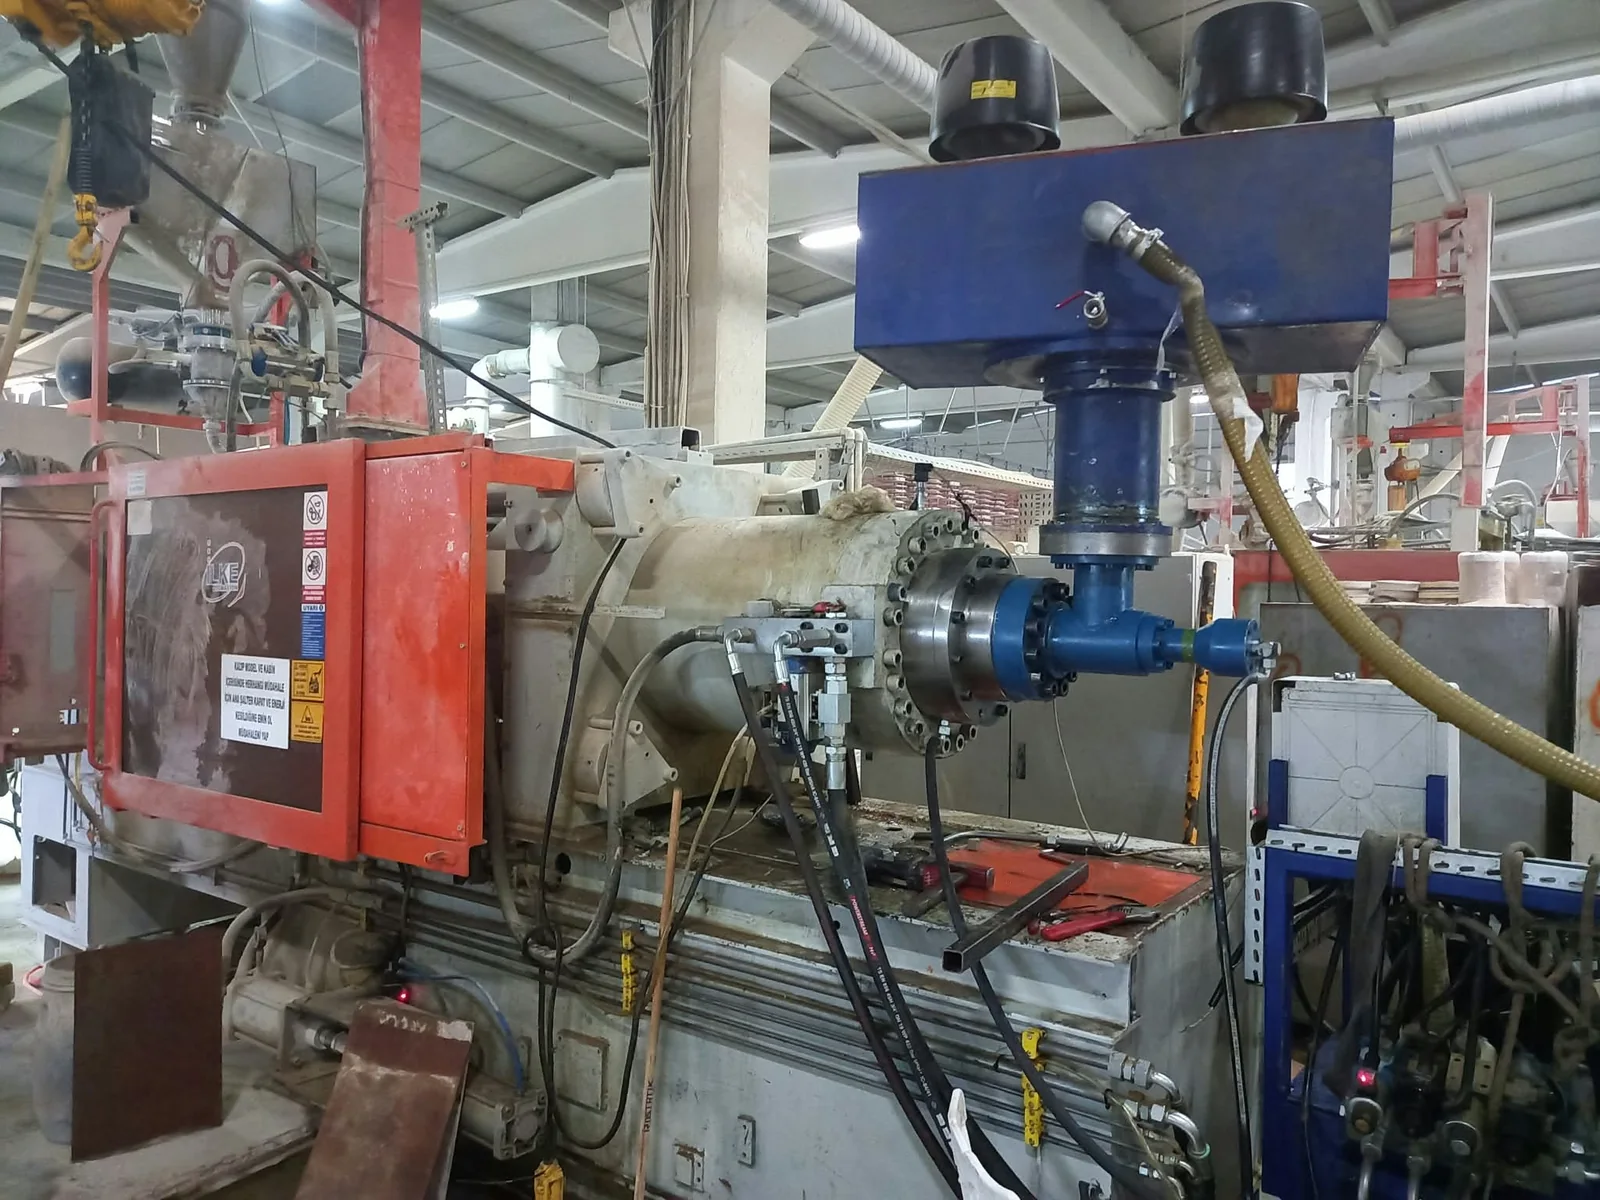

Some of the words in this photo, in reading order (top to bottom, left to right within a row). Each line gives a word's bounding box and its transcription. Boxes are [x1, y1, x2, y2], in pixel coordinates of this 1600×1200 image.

[245, 662, 257, 672] MODEL
[258, 664, 263, 673] VE
[266, 699, 271, 708] VE
[879, 973, 886, 982] EN
